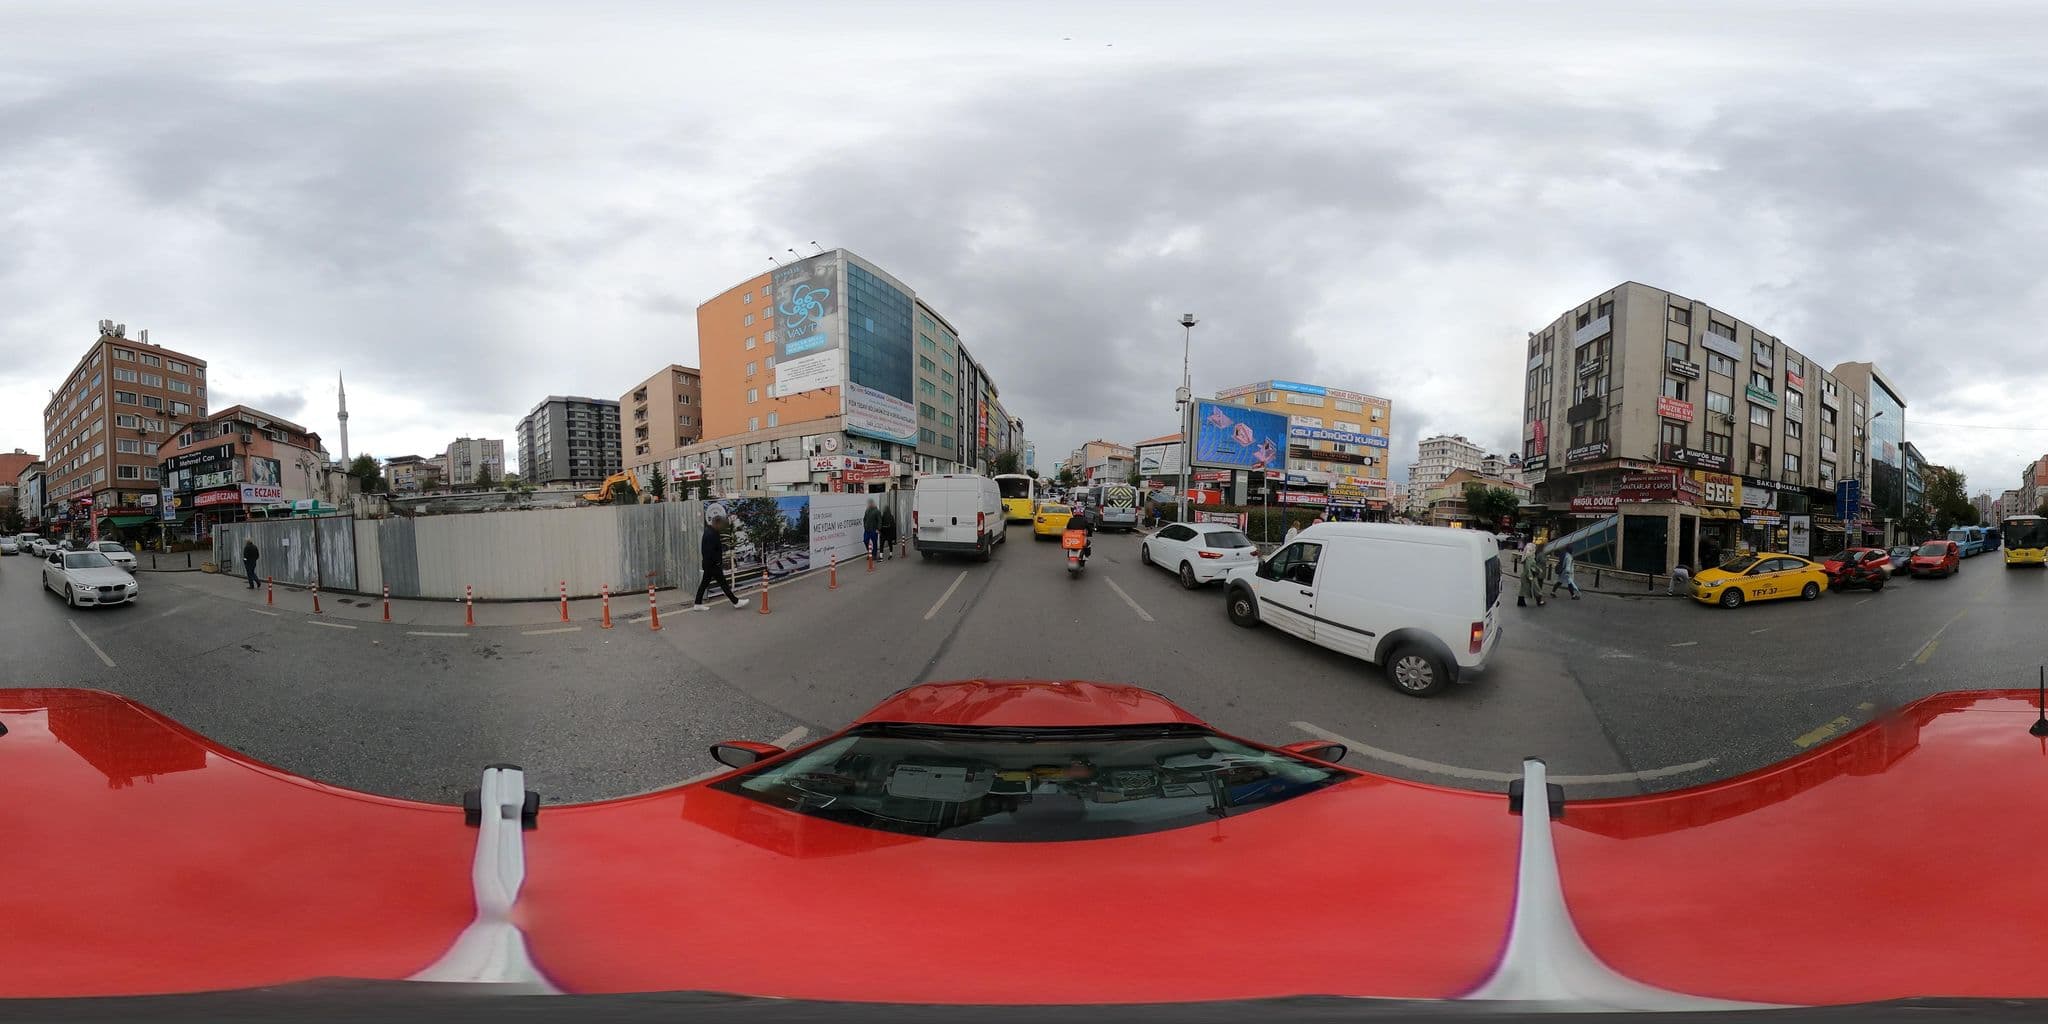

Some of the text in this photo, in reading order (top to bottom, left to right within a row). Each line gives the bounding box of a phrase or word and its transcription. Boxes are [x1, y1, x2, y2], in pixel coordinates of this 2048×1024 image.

[1312, 429, 1353, 442] SÜRÜCÜ
[1354, 435, 1387, 447] KURSU
[1756, 479, 1775, 488] SAKLI
[217, 491, 240, 500] ECZANE
[254, 487, 281, 498] ECZANE
